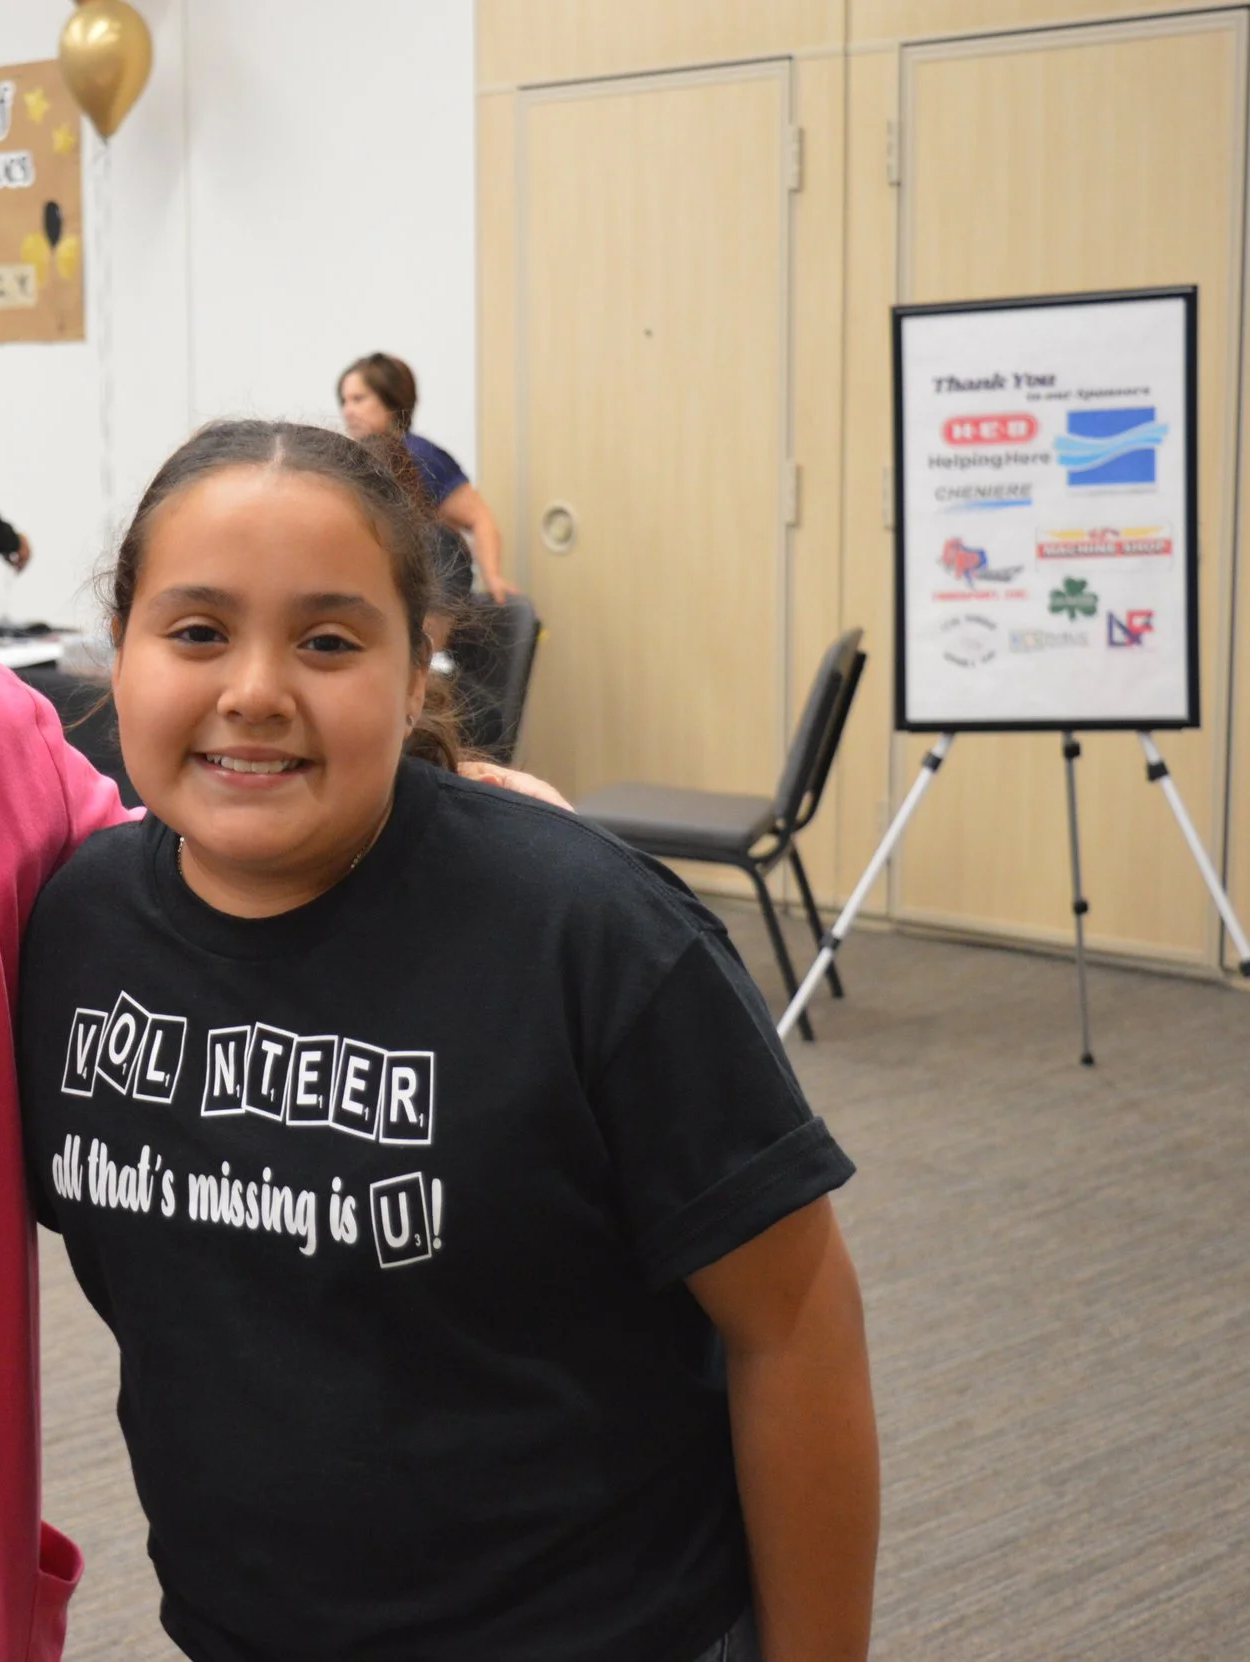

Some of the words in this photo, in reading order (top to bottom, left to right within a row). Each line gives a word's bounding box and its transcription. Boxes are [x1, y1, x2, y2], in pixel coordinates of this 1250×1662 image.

[931, 372, 1007, 394] Thank
[1012, 372, 1056, 389] You
[934, 483, 1033, 502] CHENIERE
[75, 1011, 171, 1088] VOL
[212, 1038, 425, 1129] NTEER
[52, 1134, 82, 1201] all
[87, 1138, 175, 1217] that's
[189, 1161, 316, 1256] missing
[329, 1176, 358, 1245] is
